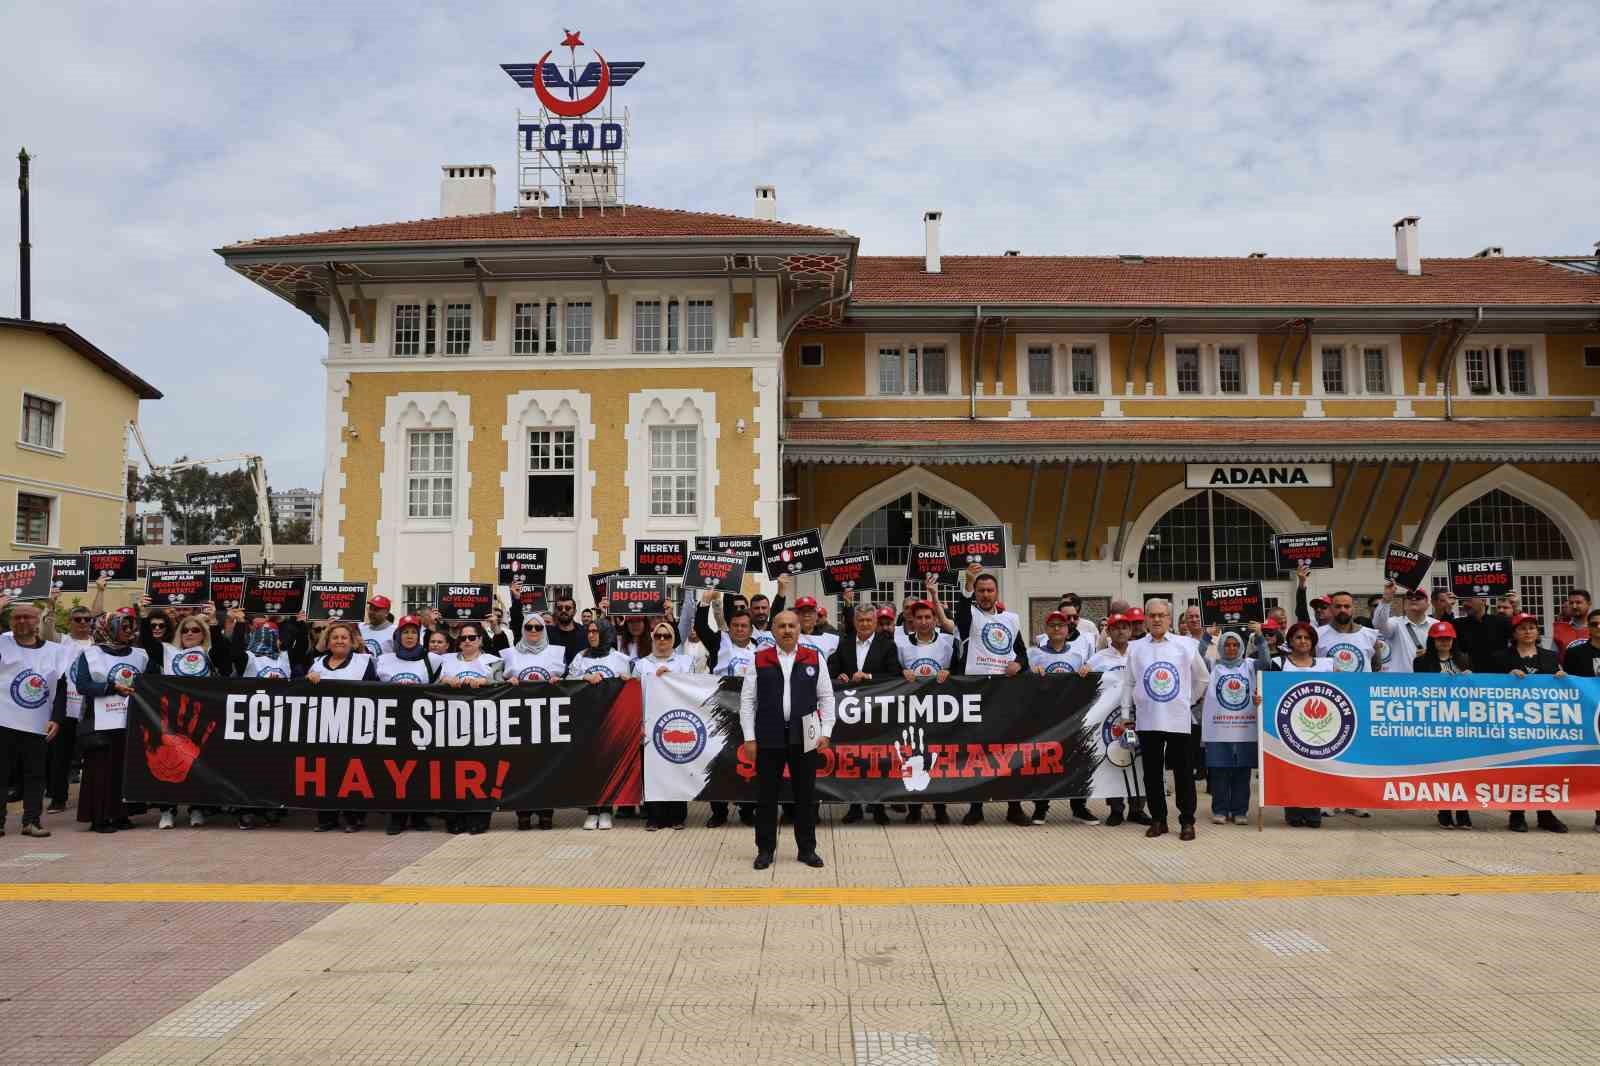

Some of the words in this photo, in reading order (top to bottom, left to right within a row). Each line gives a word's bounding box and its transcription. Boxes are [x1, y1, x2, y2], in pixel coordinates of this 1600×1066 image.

[518, 123, 622, 150] TCDD
[1209, 467, 1309, 485] ADANA
[952, 531, 995, 542] NEREYE
[643, 544, 680, 553] NEREYE
[772, 543, 784, 552] BU
[950, 545, 966, 556] BU
[967, 543, 999, 555] GİDİŞ
[53, 559, 77, 568] İDİŞE
[640, 554, 655, 564] BU
[824, 558, 845, 567] KULDA
[0, 562, 36, 574] KULDA
[1458, 562, 1503, 573] NEREYE
[258, 580, 296, 589] ŞİDDET
[616, 580, 657, 589] NEREYE
[1455, 575, 1472, 585] BU
[1475, 573, 1508, 585] GİDİŞ
[448, 587, 481, 596] ŞİDDET
[612, 592, 628, 601] BU
[630, 591, 660, 603] GİDİŞ
[1211, 587, 1248, 599] ŞİDDET
[1369, 686, 1447, 699] MEMUR-SEN
[1450, 686, 1580, 701] KONFEDERASYONU
[833, 689, 983, 725] ĞİTİMDE
[1370, 698, 1584, 725] EĞİTİM-BİR-SEN
[224, 689, 398, 745] EĞİTİMDE
[411, 694, 572, 750] ŞİDDETE
[1370, 723, 1453, 738] EĞİTİMCİLER
[1455, 723, 1505, 740] BİRLİĞİ
[1508, 725, 1584, 741] SENDİKASI
[929, 741, 1064, 779] HAYIR
[294, 755, 510, 799] HAYIR!
[1383, 781, 1468, 803] ADANA
[1475, 778, 1570, 808] ŞUBESİ
